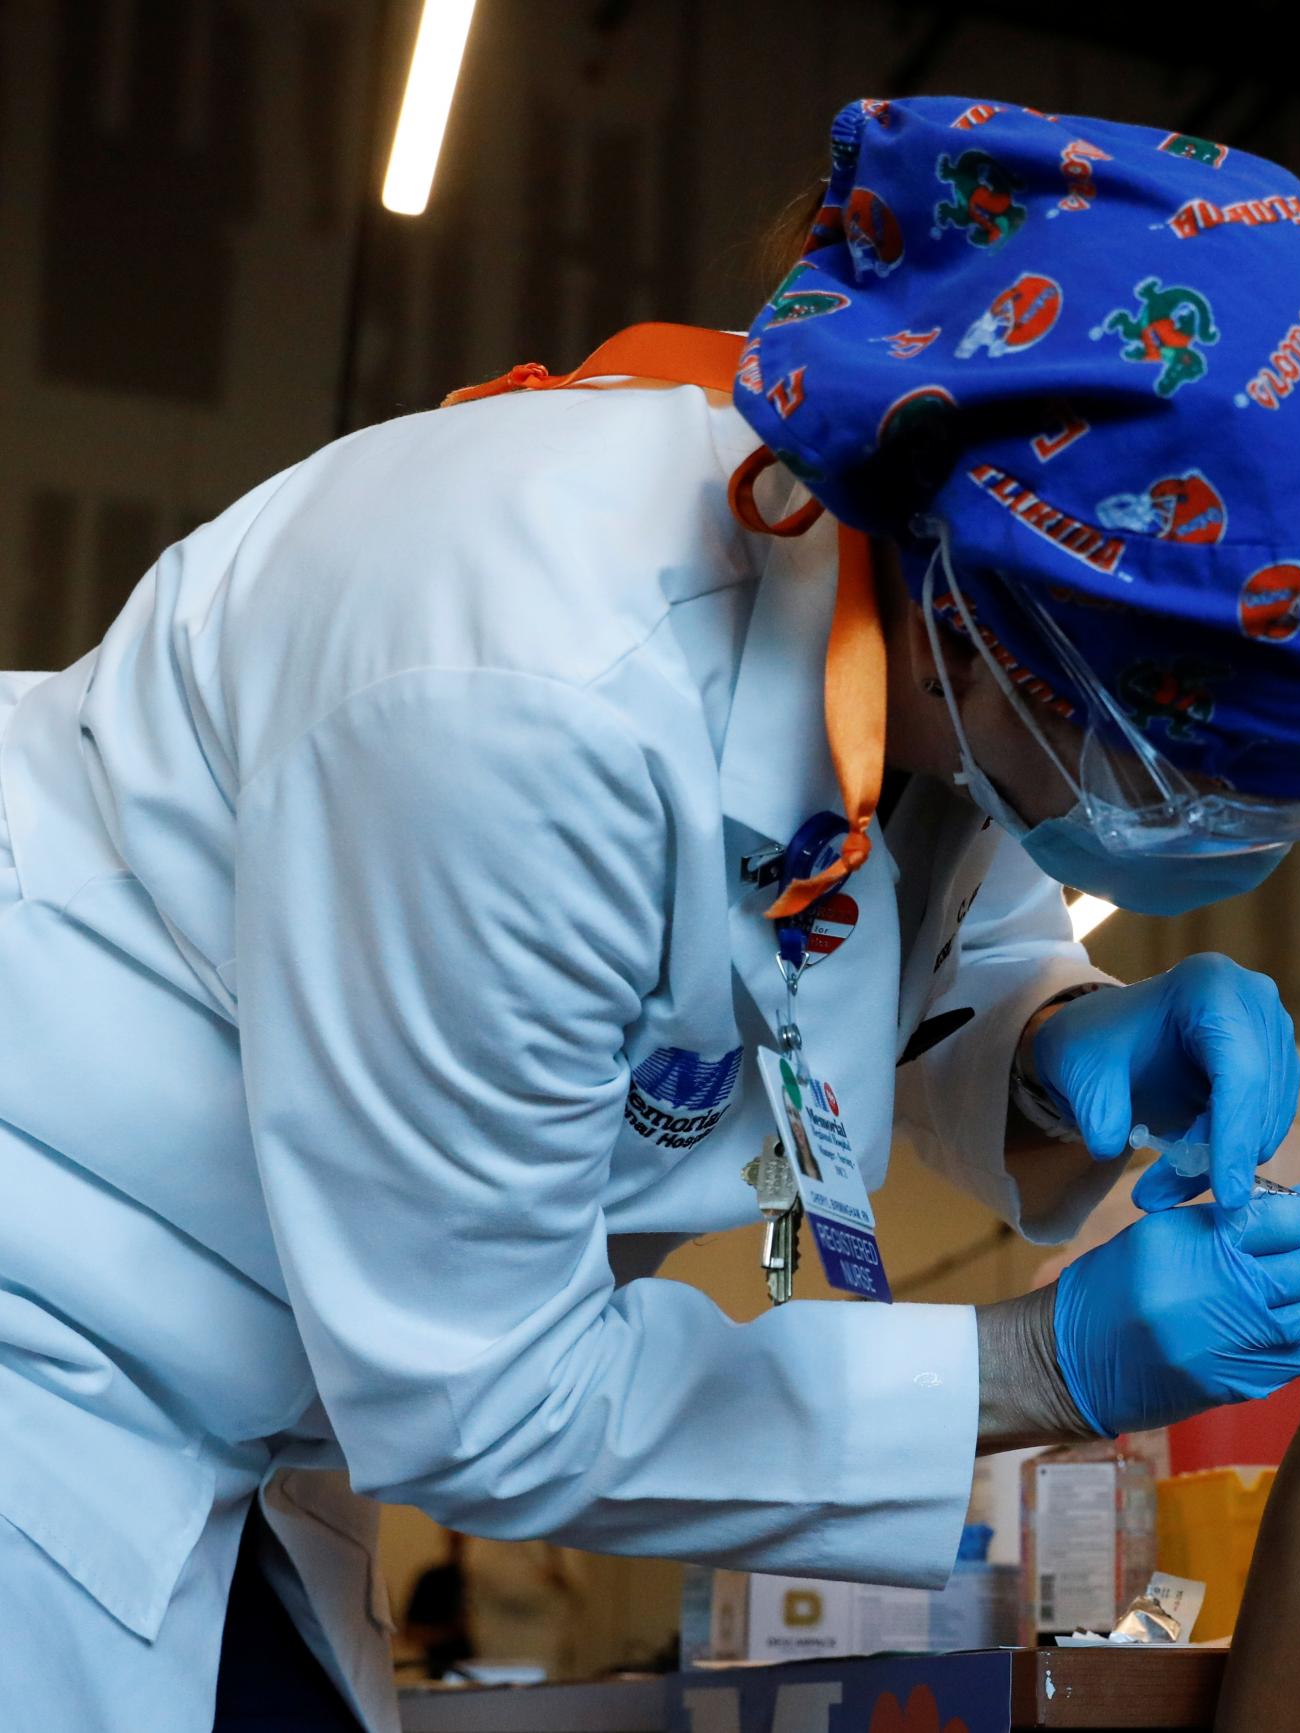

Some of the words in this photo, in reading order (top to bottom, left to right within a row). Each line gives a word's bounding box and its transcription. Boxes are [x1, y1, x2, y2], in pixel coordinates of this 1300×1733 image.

[627, 1080, 733, 1134] emorial
[805, 1105, 848, 1139] Memorial
[815, 1221, 879, 1267] REGISTERED
[839, 1259, 877, 1294] NURSE
